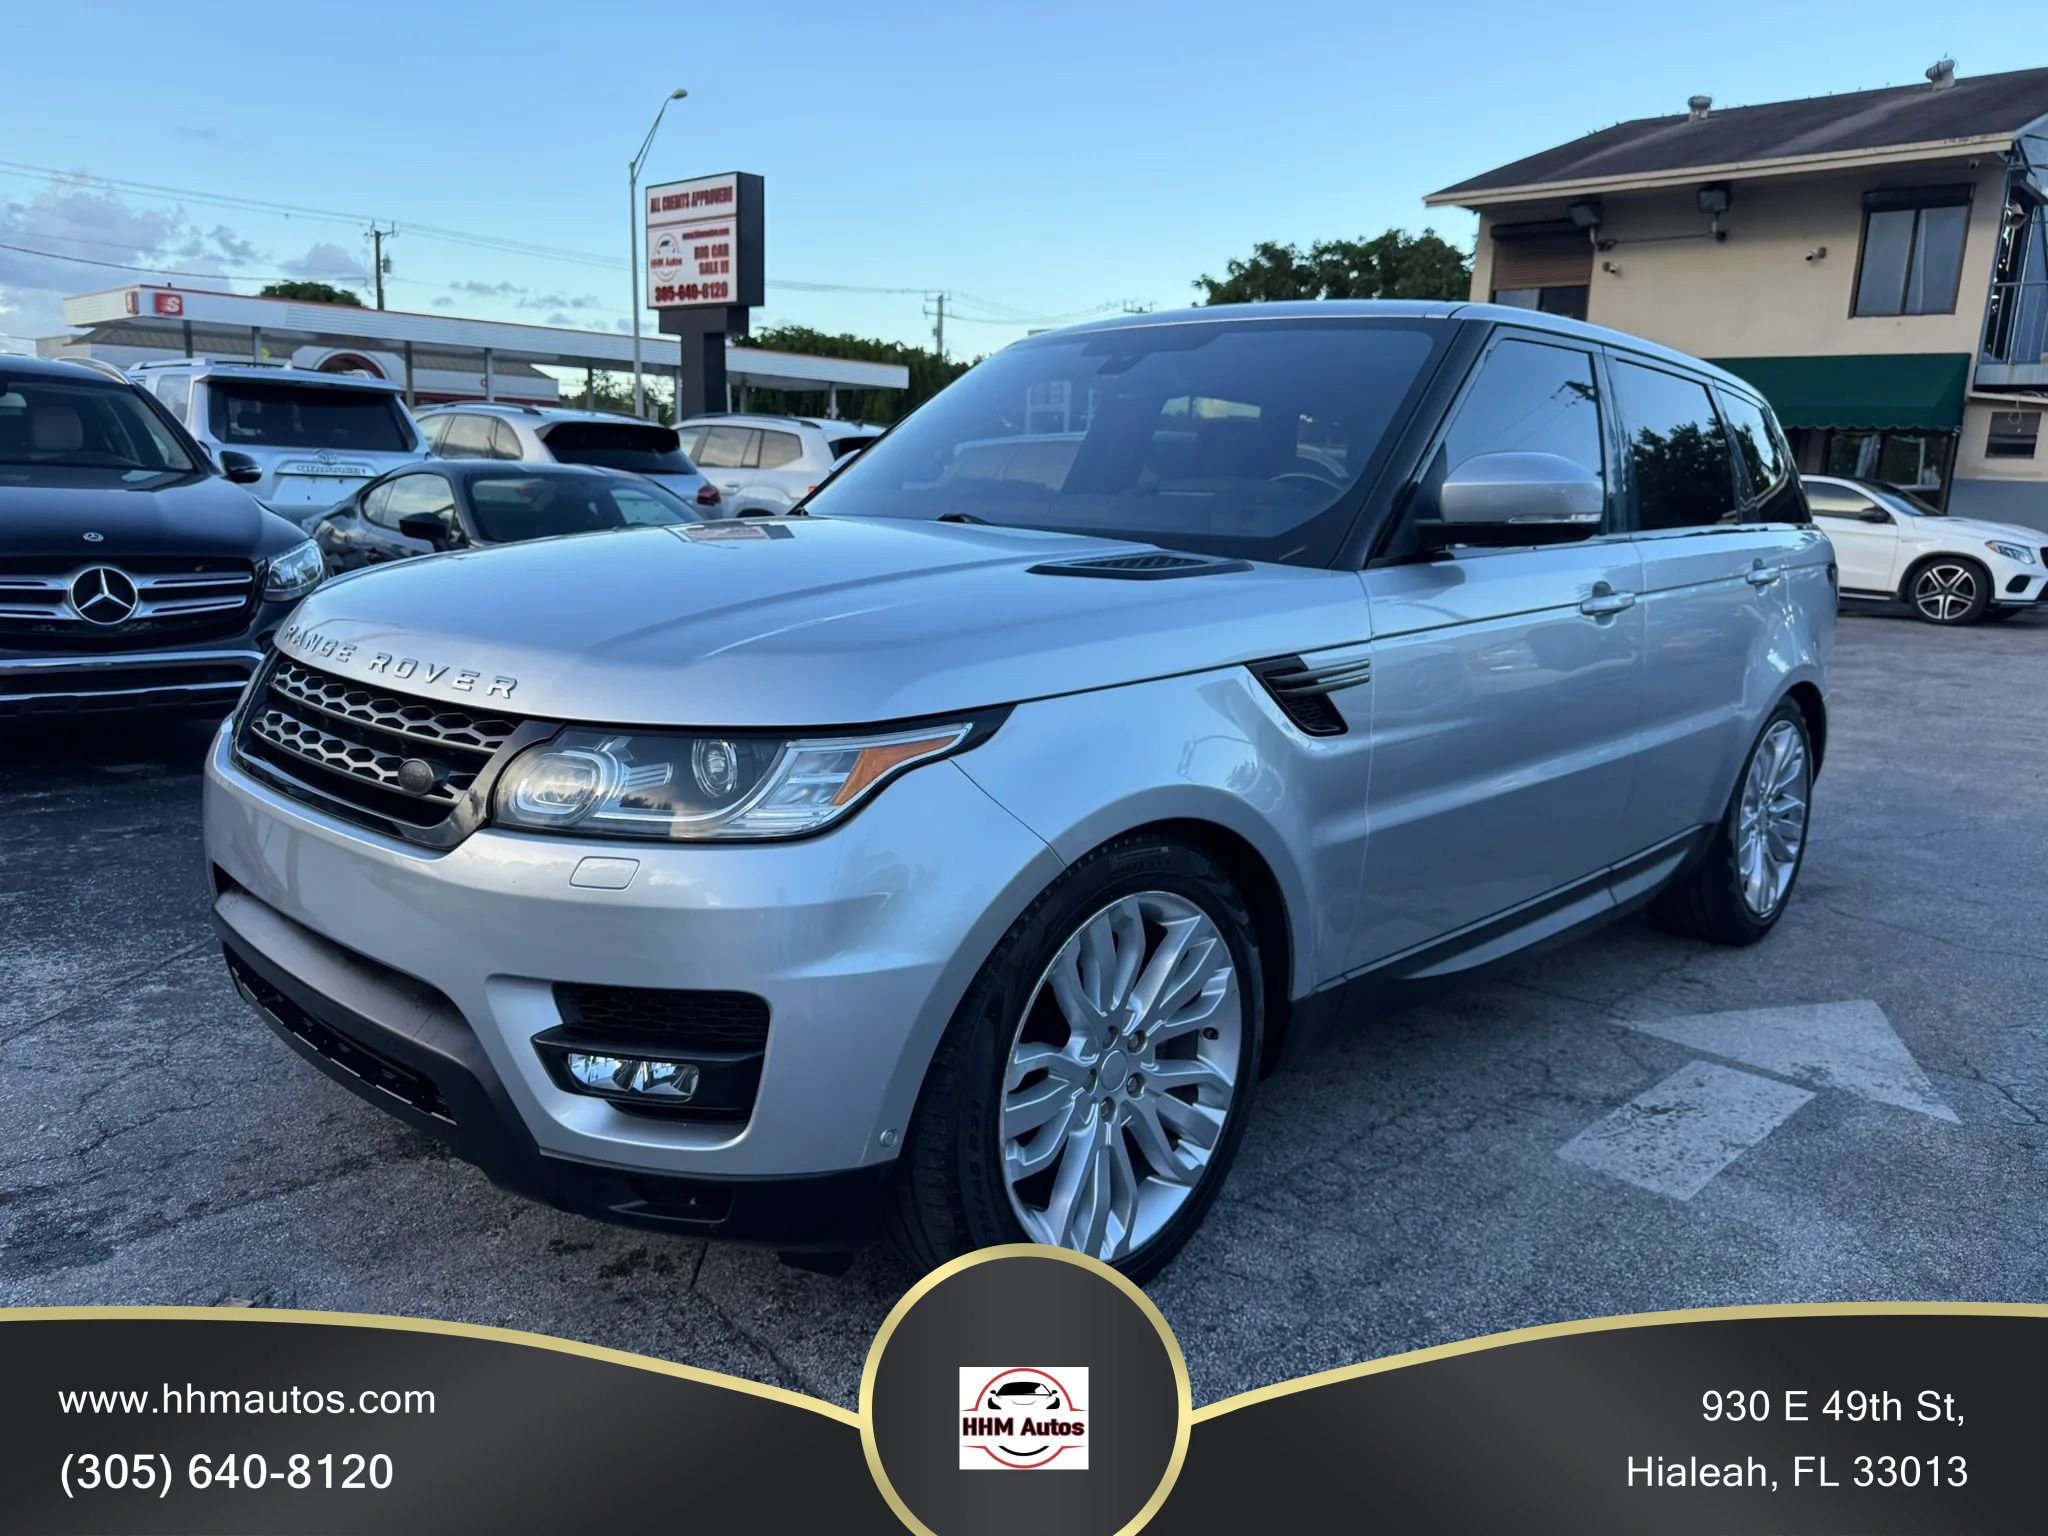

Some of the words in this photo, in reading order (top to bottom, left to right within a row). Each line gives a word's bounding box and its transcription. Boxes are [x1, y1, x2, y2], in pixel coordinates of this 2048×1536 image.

[650, 197, 661, 213] ALL
[711, 243, 730, 258] CAR
[699, 261, 719, 276] SALE
[655, 282, 728, 302] 305-640-8120
[284, 624, 357, 663] RANGE
[369, 652, 517, 699] ROVER
